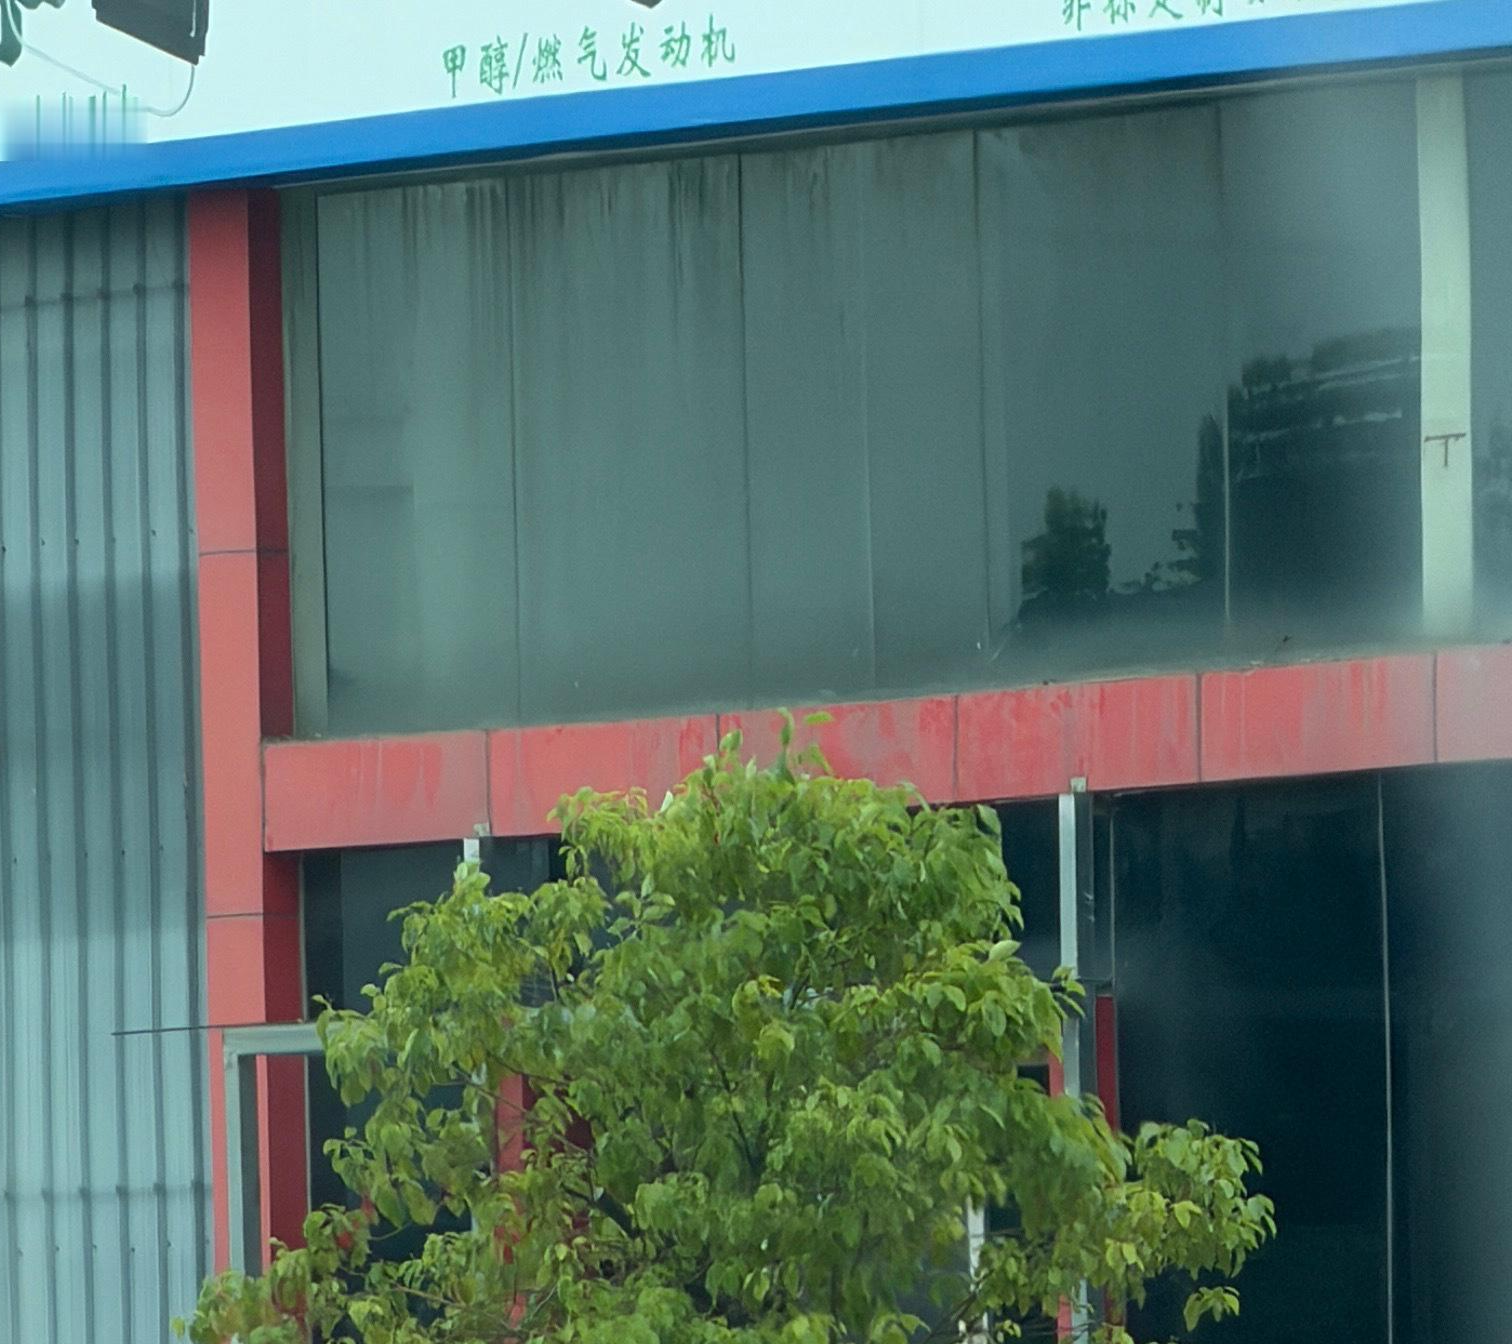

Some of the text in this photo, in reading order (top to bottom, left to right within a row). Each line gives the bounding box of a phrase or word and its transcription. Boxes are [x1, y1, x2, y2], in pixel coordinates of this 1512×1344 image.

[443, 14, 736, 98] 甲醇/燃气发动机
